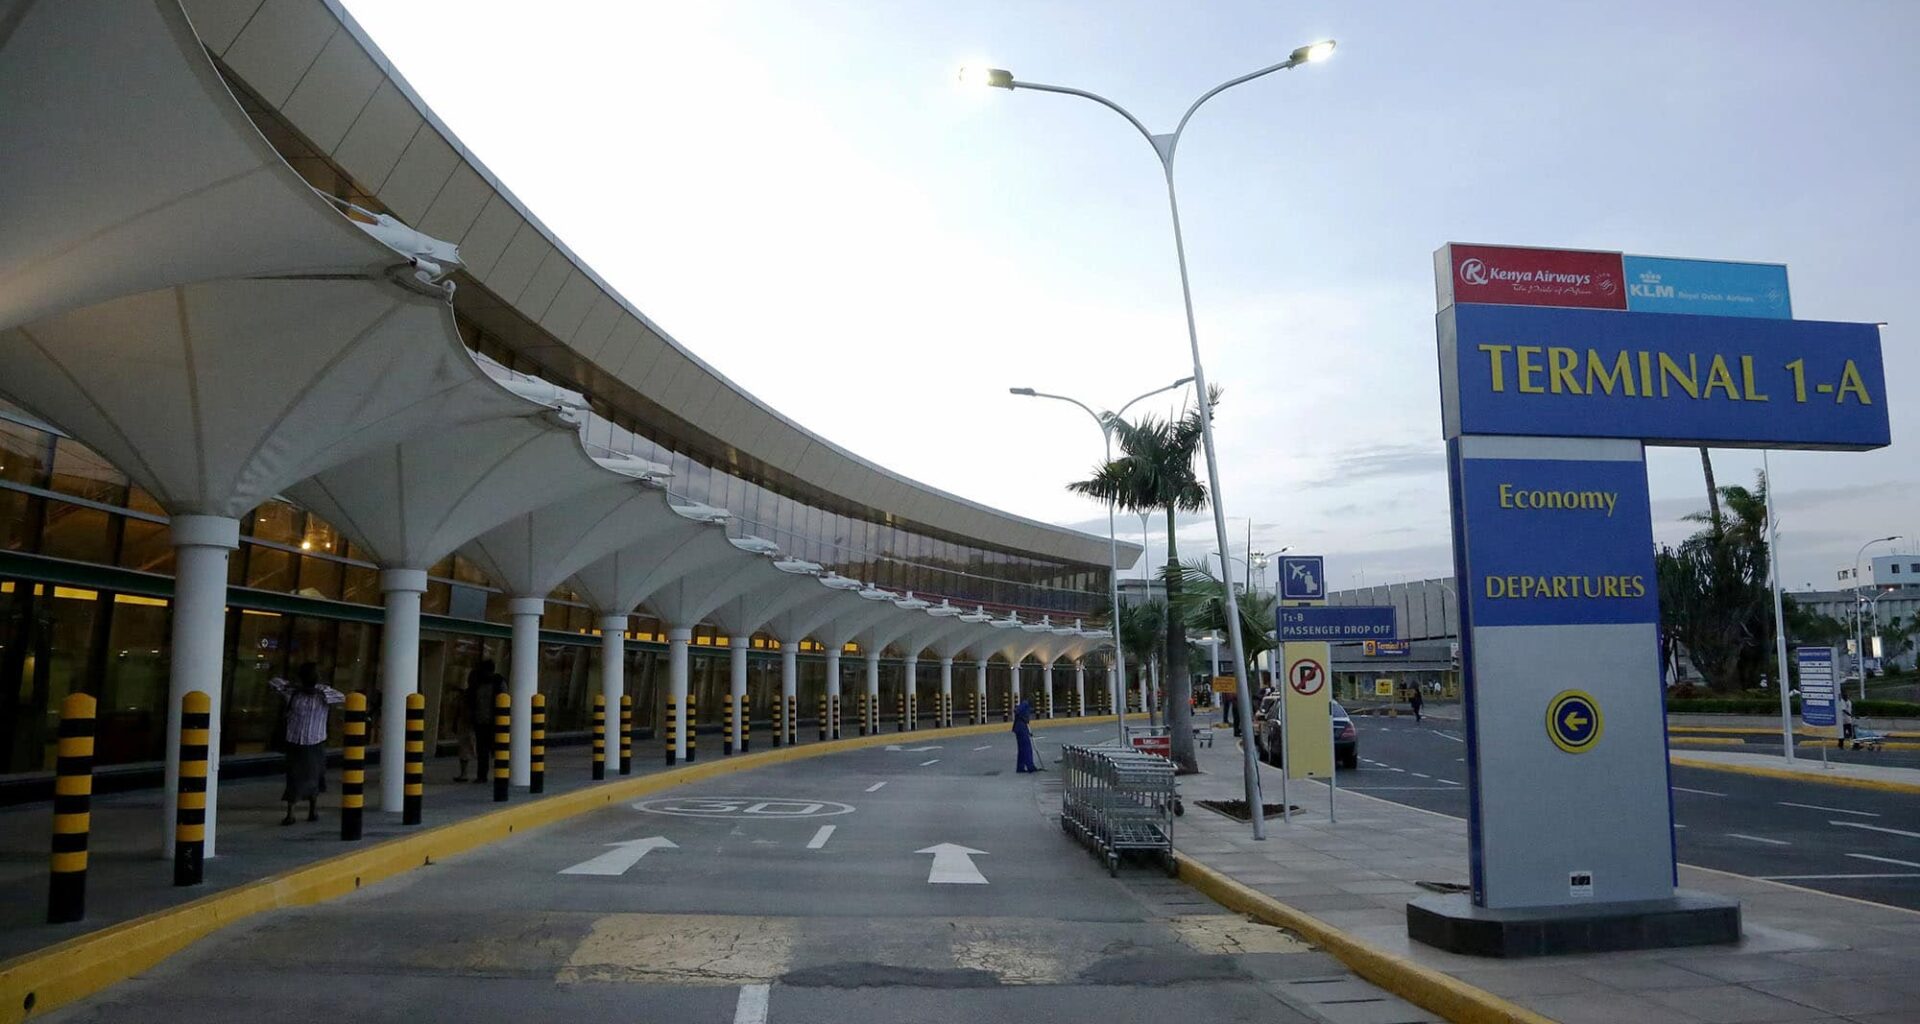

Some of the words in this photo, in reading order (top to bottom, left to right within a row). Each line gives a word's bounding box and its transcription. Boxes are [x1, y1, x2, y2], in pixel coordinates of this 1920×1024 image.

[1490, 267, 1532, 284] Kenya
[1534, 270, 1591, 286] Airways
[1630, 284, 1674, 298] KLM
[1478, 344, 1769, 402] TERMINAL
[1785, 358, 1872, 405] 1-A
[1499, 483, 1618, 517] Economy
[1486, 575, 1646, 599] DEPARTURES
[1283, 613, 1304, 622] T1-B
[1283, 625, 1341, 635] PASSENGER
[1344, 625, 1371, 634] DROP
[1373, 624, 1391, 634] OFF
[664, 799, 825, 815] 30
